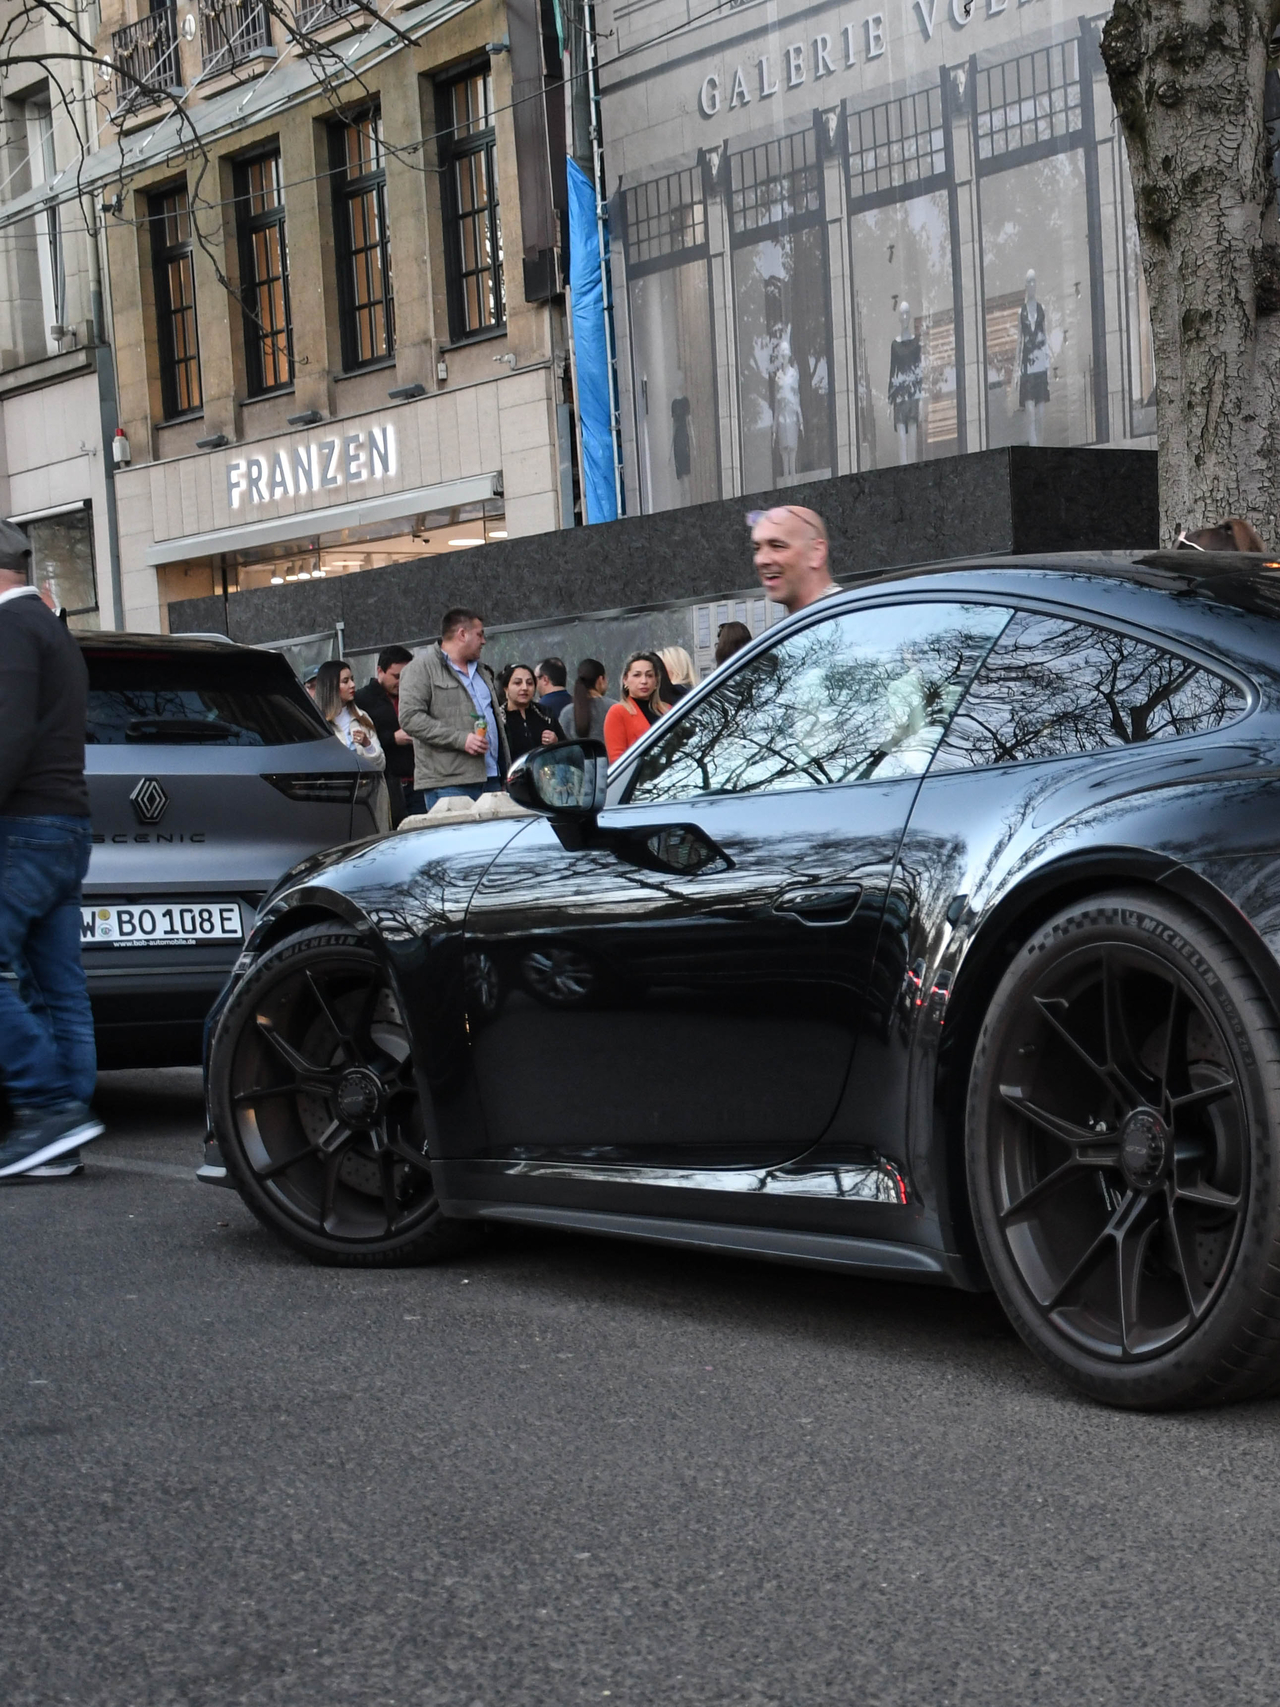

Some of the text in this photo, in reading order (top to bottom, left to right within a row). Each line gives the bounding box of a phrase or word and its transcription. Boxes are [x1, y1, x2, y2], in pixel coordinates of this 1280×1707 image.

[699, 12, 888, 118] GALERIE
[226, 424, 397, 508] FRANZEN
[92, 833, 206, 844] SCENIC
[282, 935, 358, 960] MICHELIN
[1141, 919, 1219, 987] MICHELIN
